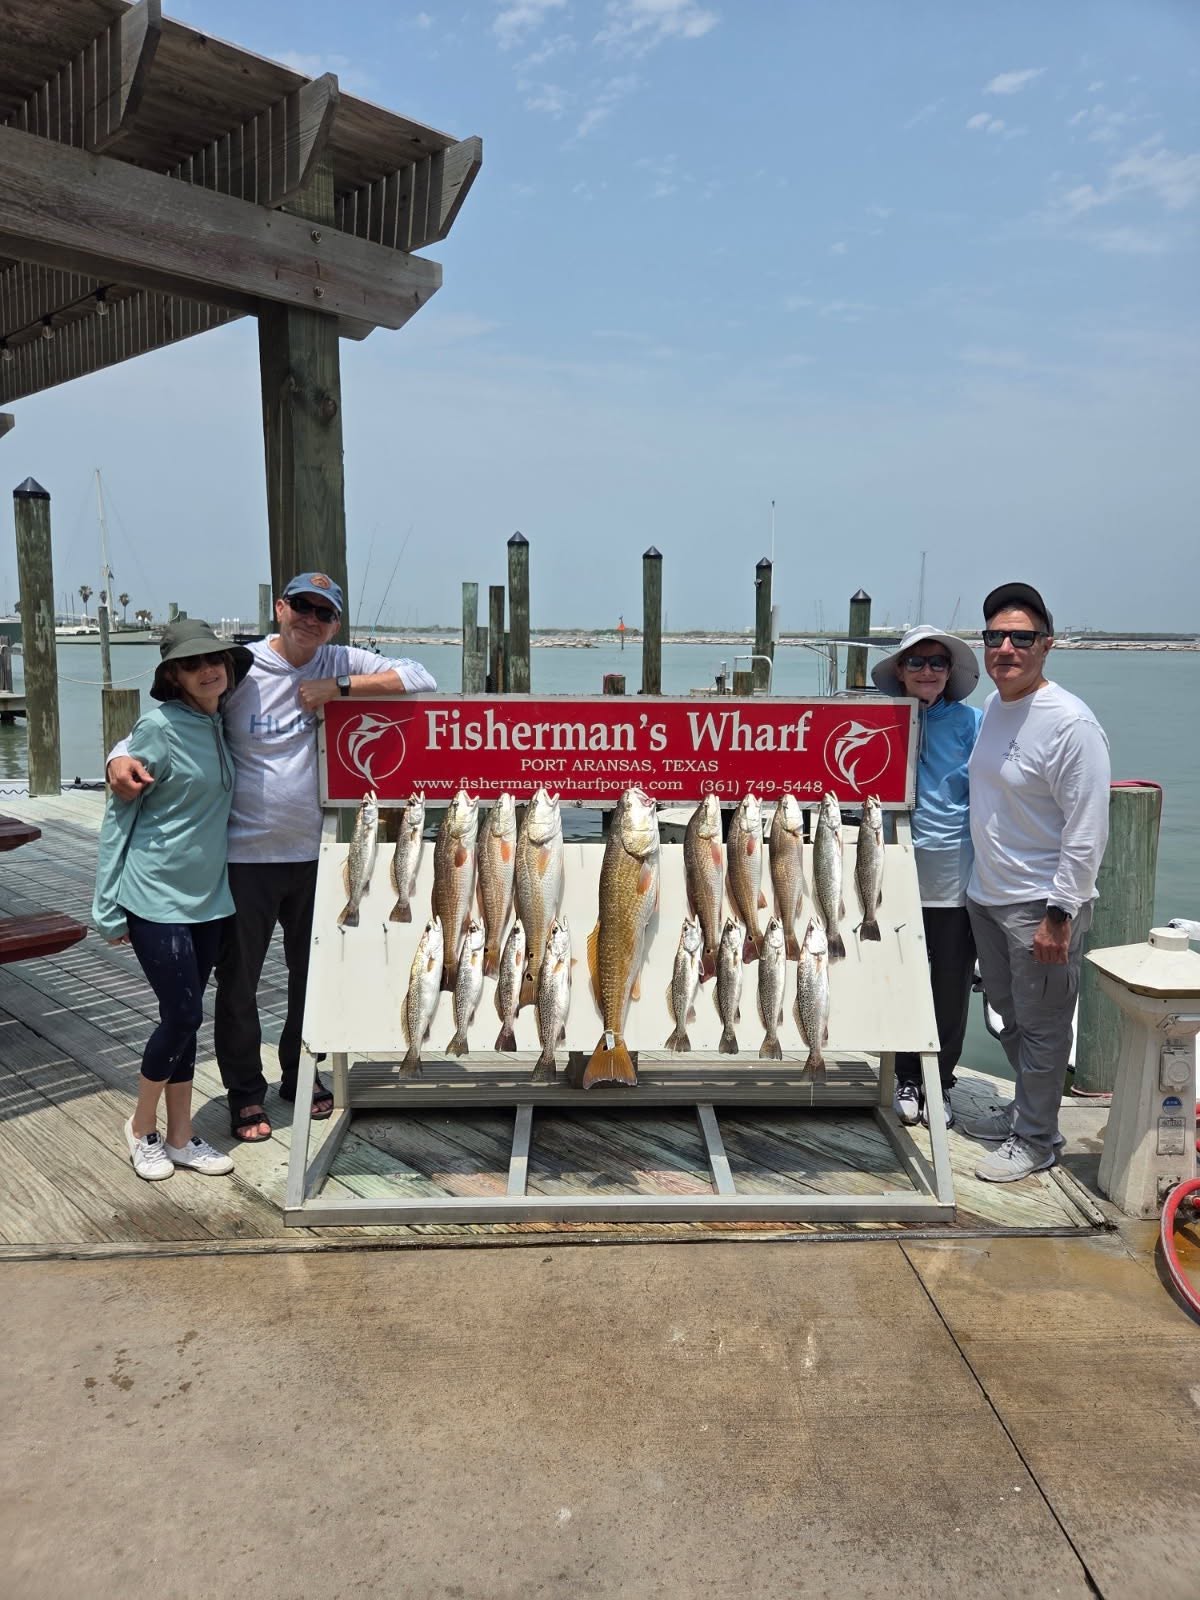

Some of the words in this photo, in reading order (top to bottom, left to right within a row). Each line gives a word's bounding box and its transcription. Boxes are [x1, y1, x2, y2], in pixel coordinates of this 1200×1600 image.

[424, 709, 668, 751] Fisherman's
[687, 710, 813, 752] Wharf
[521, 759, 567, 772] PORT
[572, 759, 657, 774] ARANSAS,
[662, 759, 719, 772] TEXAS
[413, 777, 683, 793] www.fishermanswharfporta.com
[700, 780, 740, 795] (361)
[745, 780, 823, 793] 749-5448
